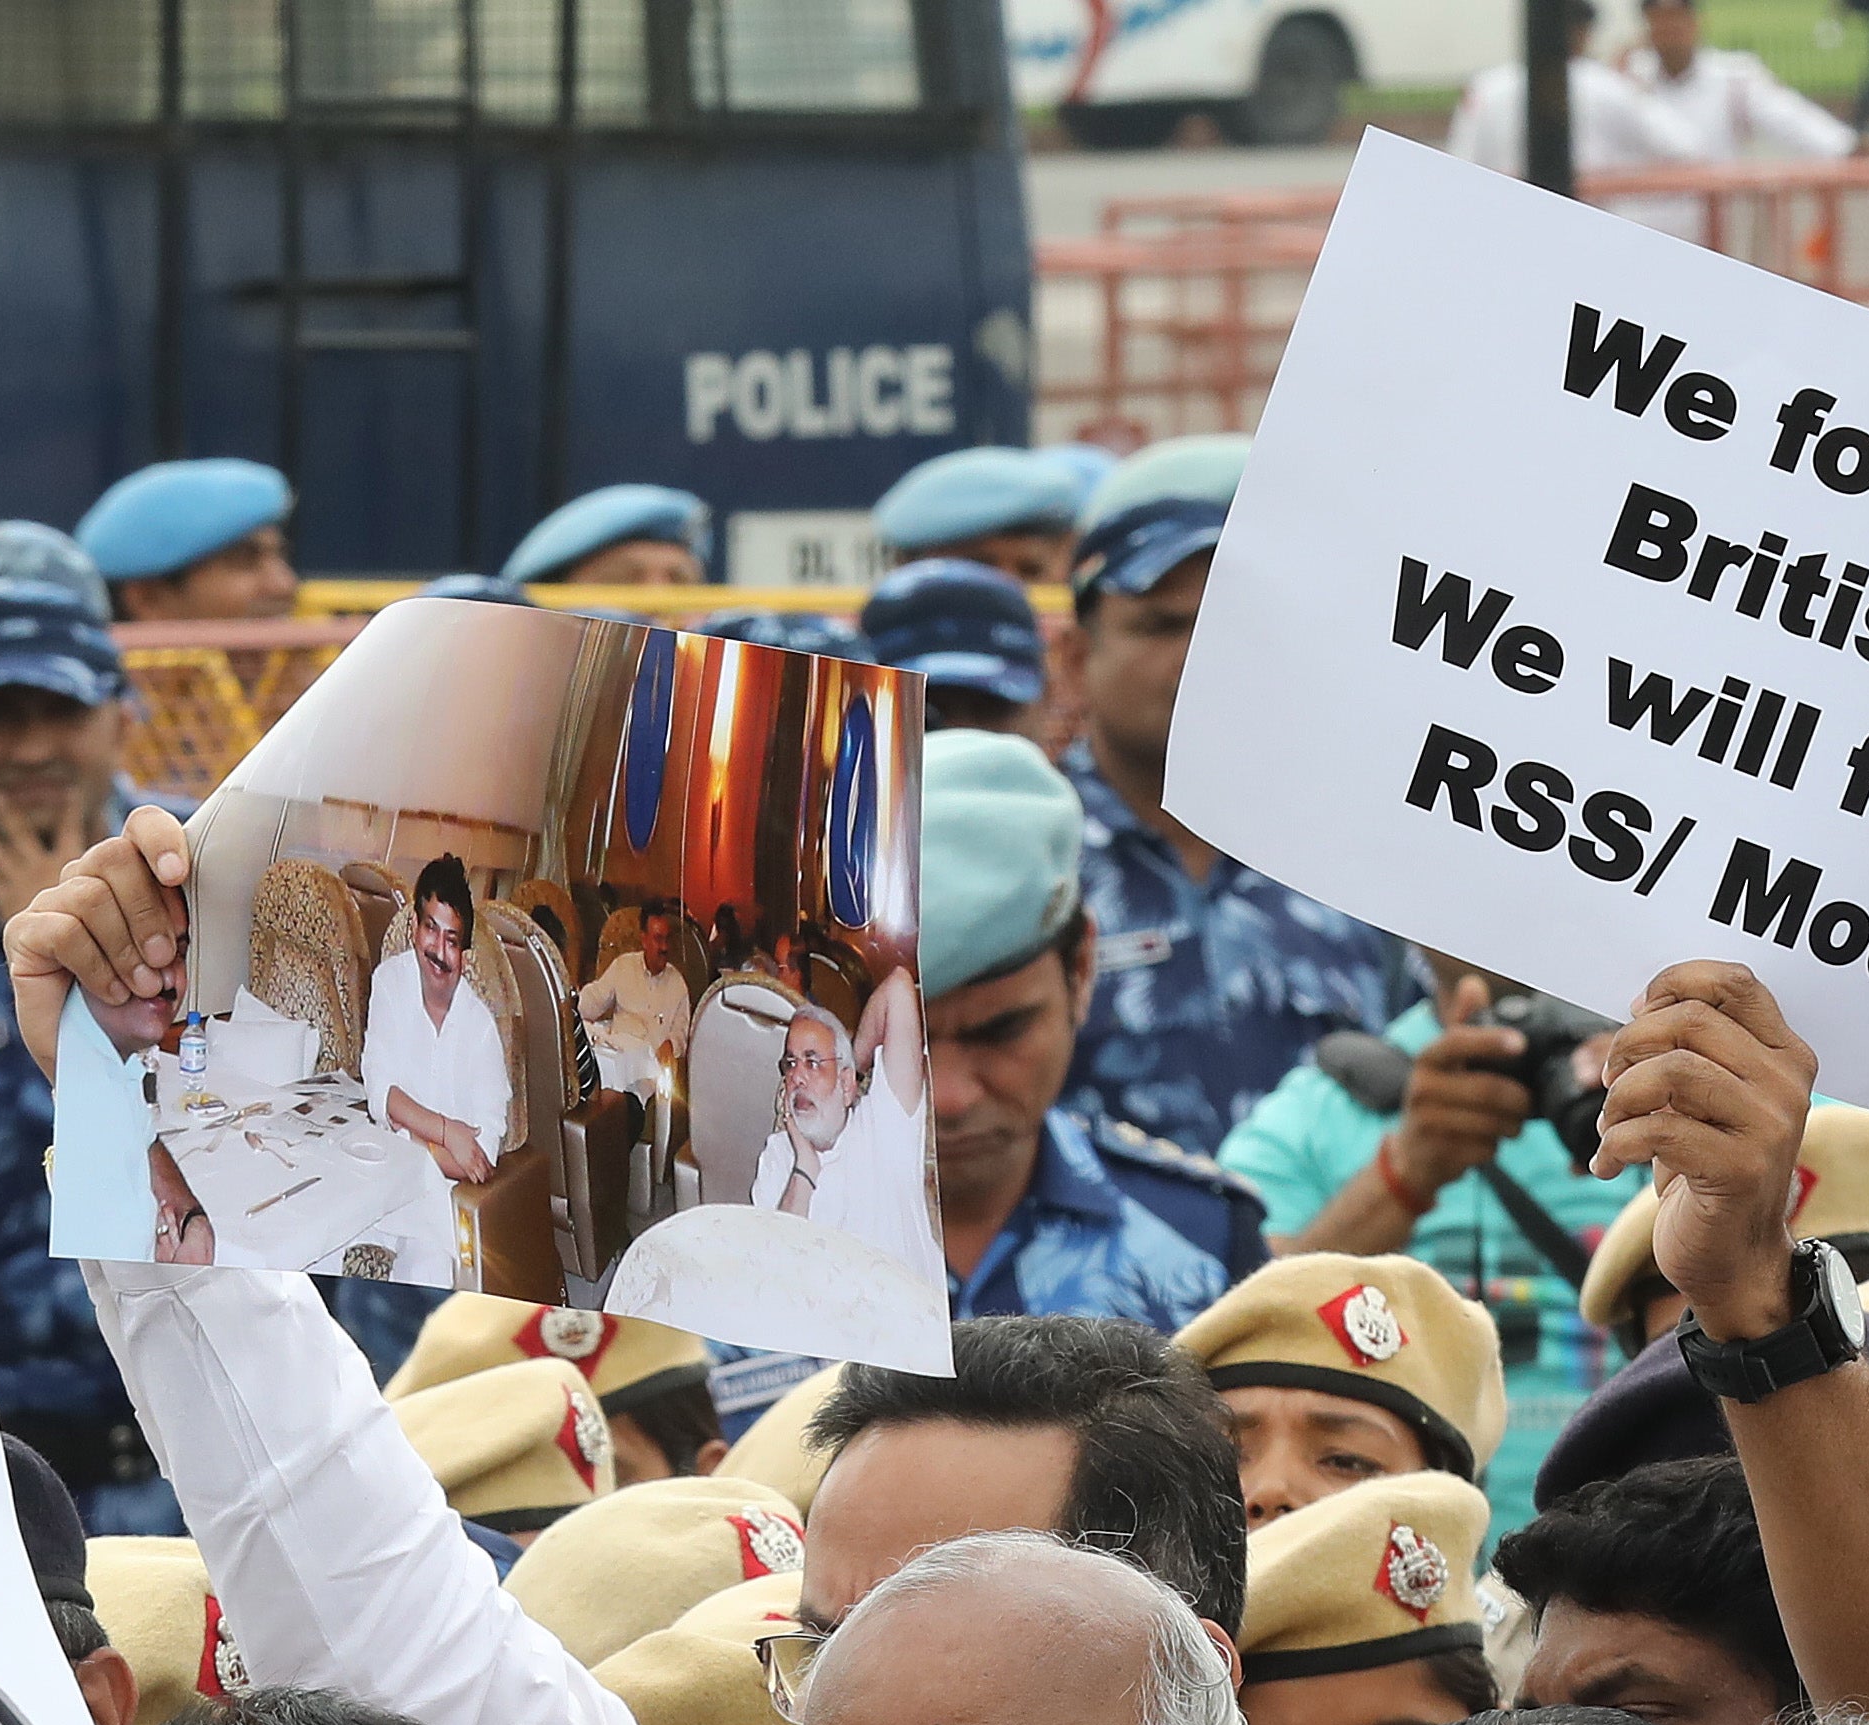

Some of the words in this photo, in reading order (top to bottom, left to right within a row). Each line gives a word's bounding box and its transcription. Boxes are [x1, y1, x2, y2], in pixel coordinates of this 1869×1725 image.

[685, 344, 954, 443] POLICE
[1564, 303, 1736, 441] We
[1393, 556, 1564, 694] We
[1609, 657, 1821, 790] will
[1405, 724, 1697, 896] RSS/
